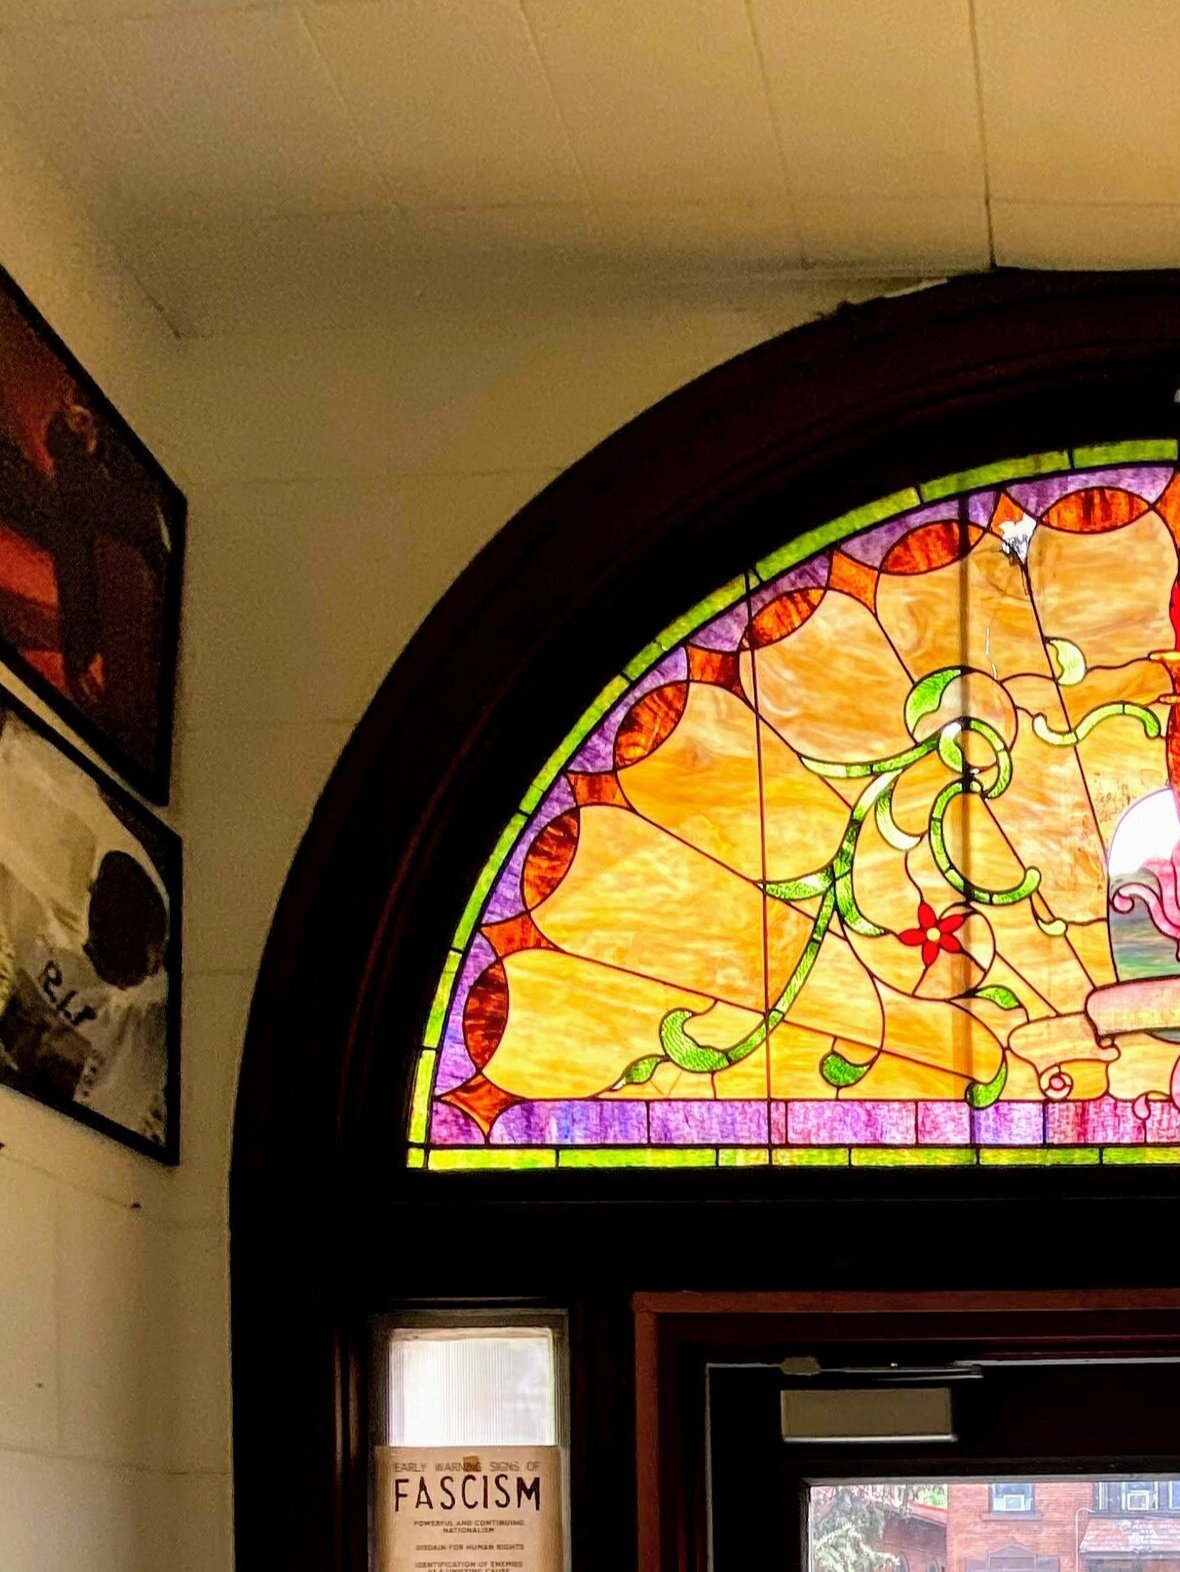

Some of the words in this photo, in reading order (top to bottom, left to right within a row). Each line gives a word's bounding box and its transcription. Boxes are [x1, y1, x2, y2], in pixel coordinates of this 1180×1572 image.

[394, 1461, 427, 1473] EARLY
[434, 1461, 482, 1473] WARNING
[489, 1460, 520, 1472] SIGNS
[526, 1460, 541, 1472] OF
[394, 1473, 541, 1512] FASCISM
[413, 1519, 453, 1527] POWERFUL
[455, 1519, 472, 1527] AND
[474, 1518, 525, 1526] CONTINUING
[442, 1527, 495, 1535] NATIONALISM
